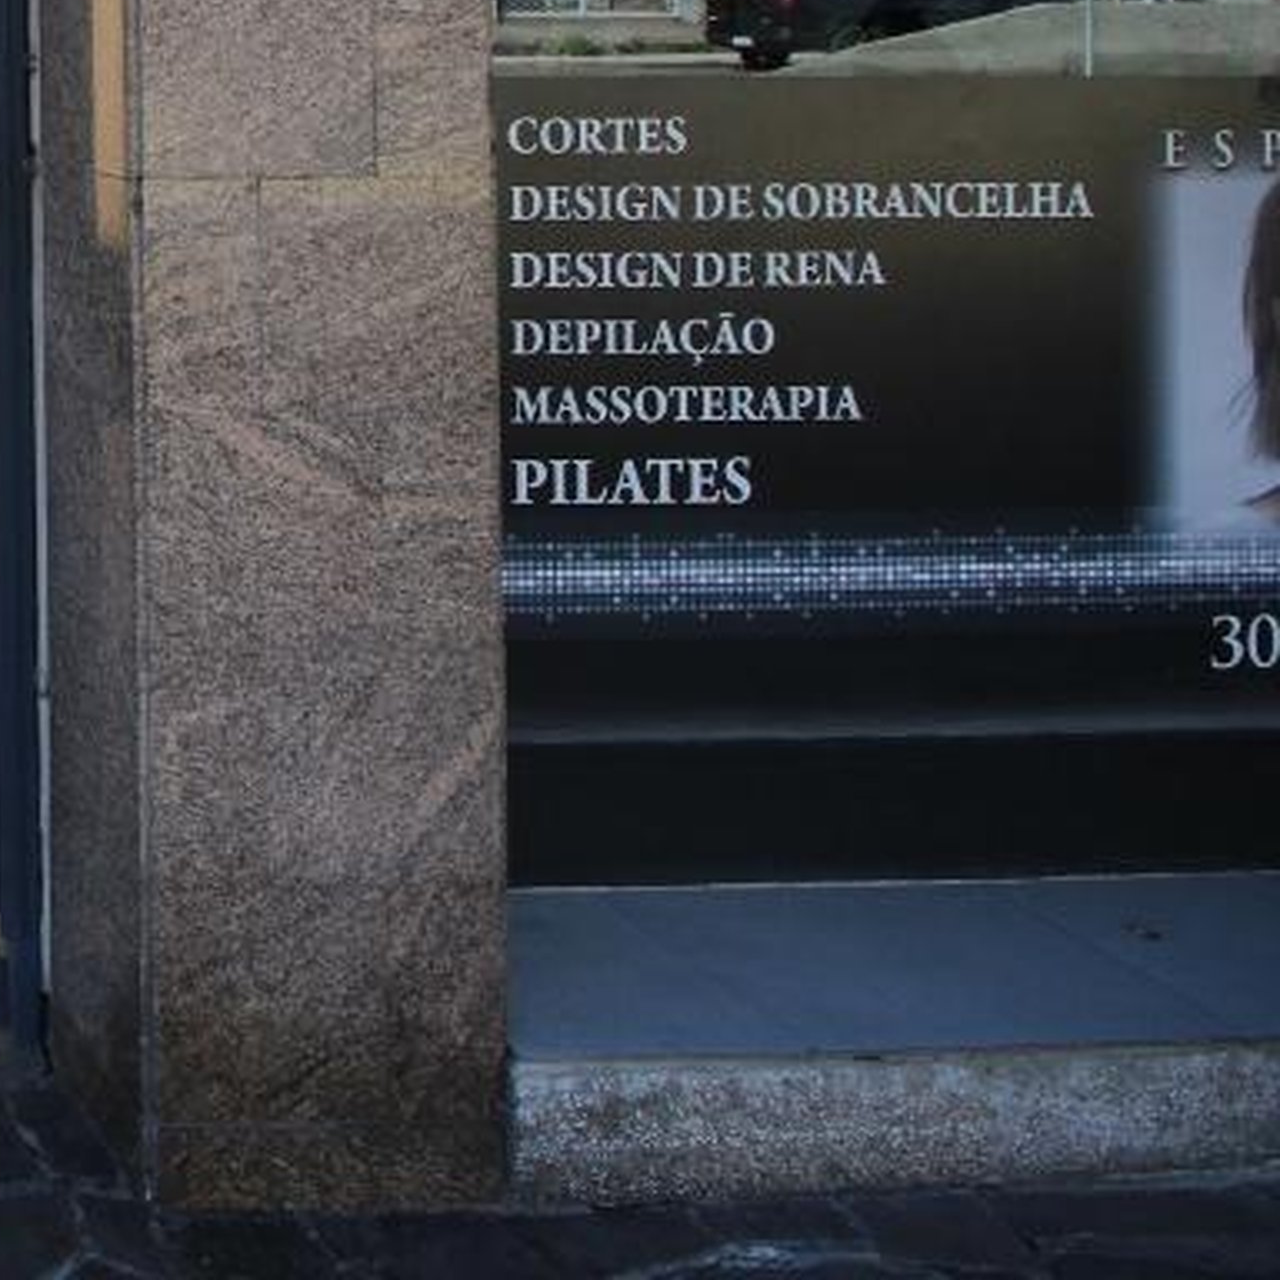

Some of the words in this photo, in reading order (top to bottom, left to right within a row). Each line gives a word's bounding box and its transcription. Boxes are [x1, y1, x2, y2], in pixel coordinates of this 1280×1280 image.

[507, 116, 688, 154] CORTES
[510, 184, 682, 221] DESIGN
[693, 184, 754, 221] DE
[762, 181, 1095, 219] SOBRANCELHA
[509, 252, 683, 288] DESIGN
[692, 252, 754, 288] DE
[763, 251, 886, 286] RENA
[511, 312, 776, 366] DEPILAÇÃO
[511, 385, 863, 424] MASSOTERAPIA
[511, 456, 753, 506] PILATES
